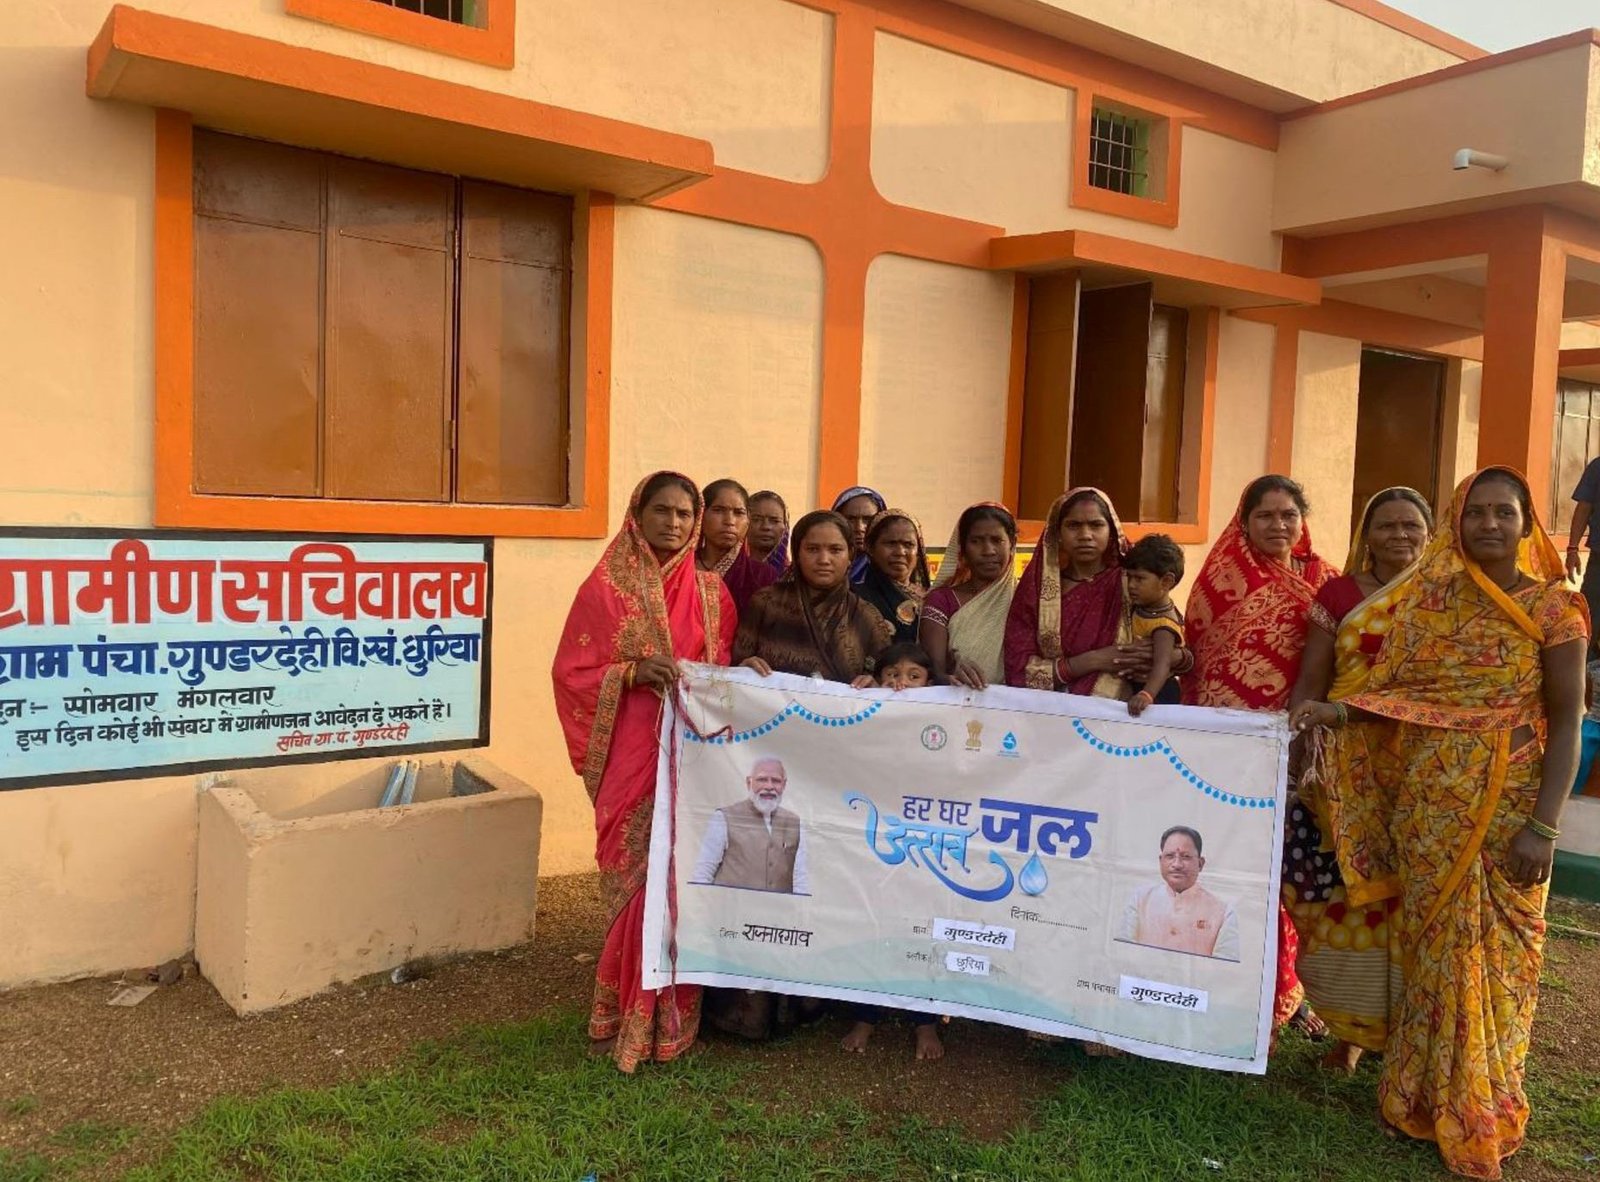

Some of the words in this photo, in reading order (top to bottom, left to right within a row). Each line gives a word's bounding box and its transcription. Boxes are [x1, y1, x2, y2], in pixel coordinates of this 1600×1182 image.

[15, 729, 51, 752] इस
[54, 720, 94, 747] दिन
[97, 716, 140, 744] कोई
[142, 714, 165, 738] भी
[217, 710, 234, 732] में
[314, 703, 370, 728] आवेदन
[388, 698, 430, 723] सकते
[63, 687, 163, 718] सोमवार
[177, 686, 282, 709] मंगलवार
[902, 795, 934, 821] हर
[938, 799, 972, 826] घर
[980, 798, 1099, 859] जल
